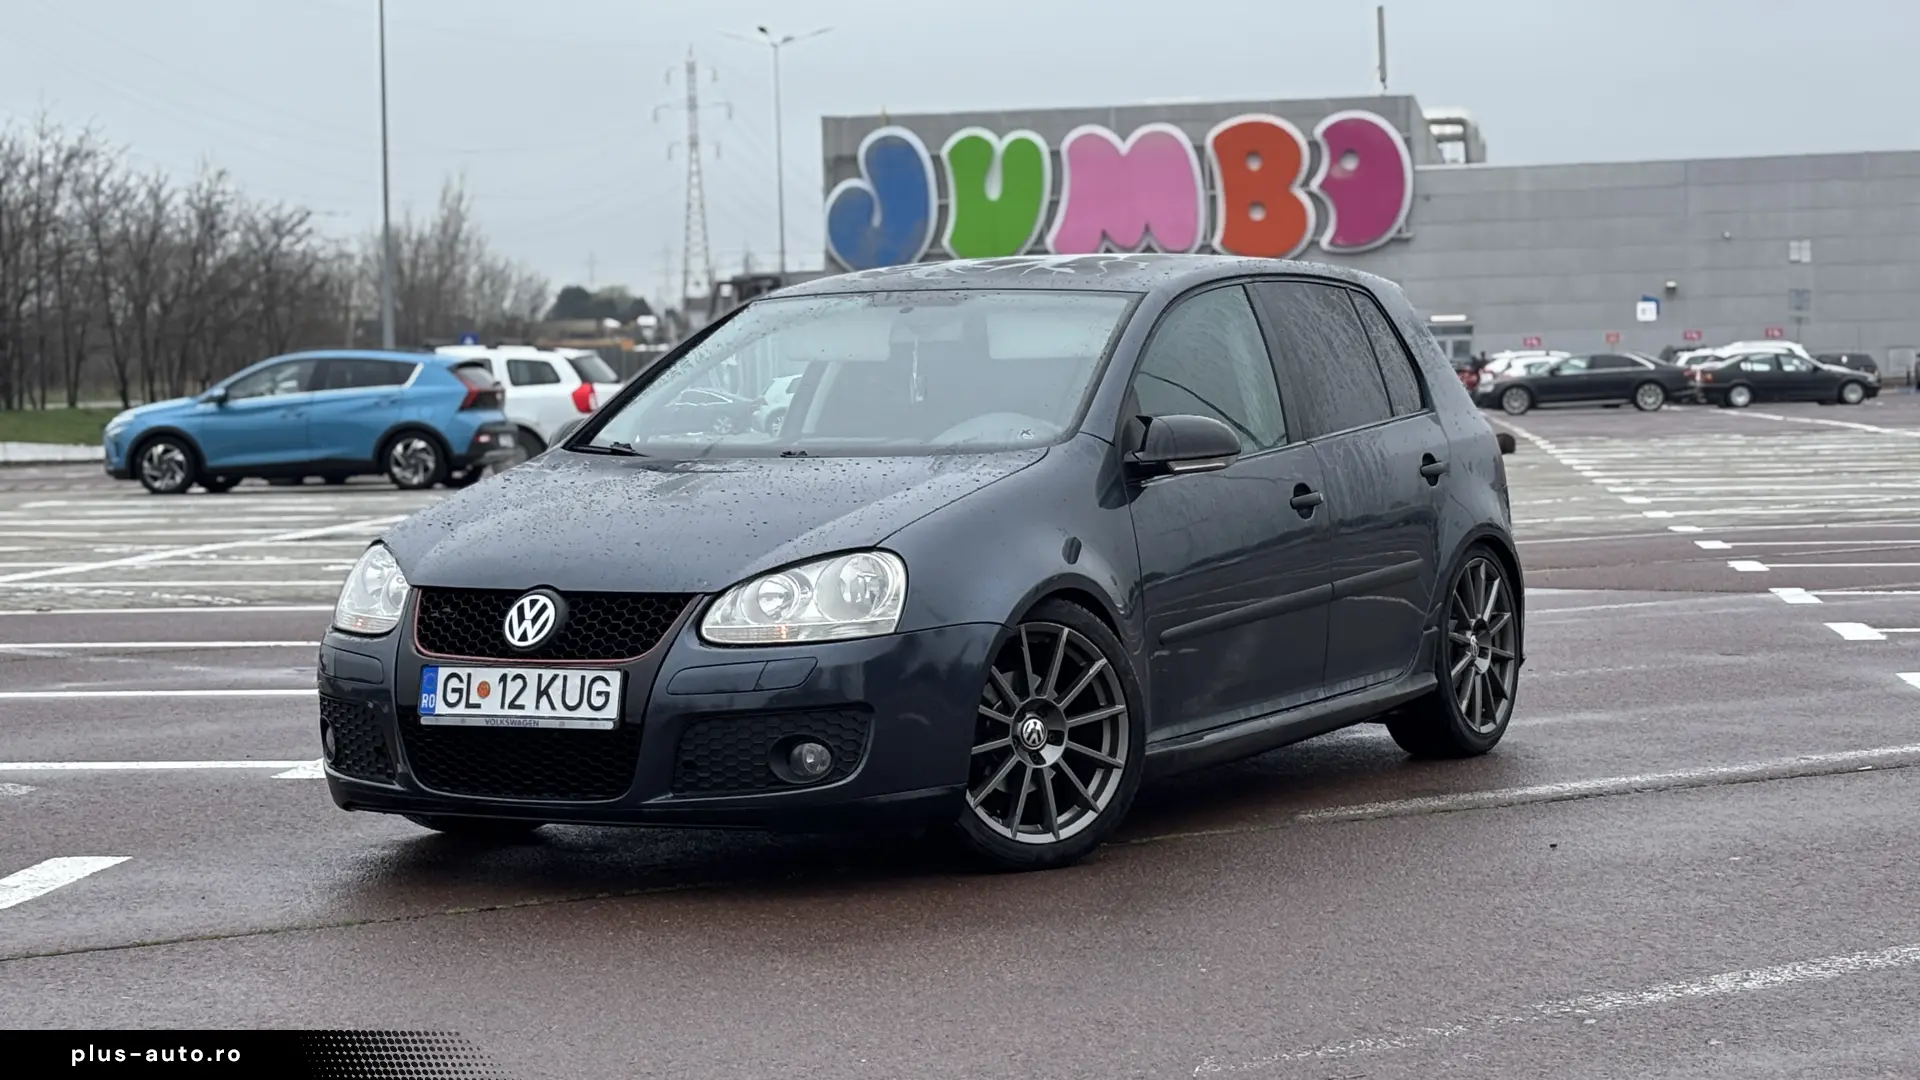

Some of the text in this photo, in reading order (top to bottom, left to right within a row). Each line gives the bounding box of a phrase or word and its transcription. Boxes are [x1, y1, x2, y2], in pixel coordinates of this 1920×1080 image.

[824, 110, 1413, 271] JUMBO
[421, 693, 436, 709] RO
[442, 672, 611, 711] GL 12 KUG
[484, 718, 540, 728] VOLKSWAGEN
